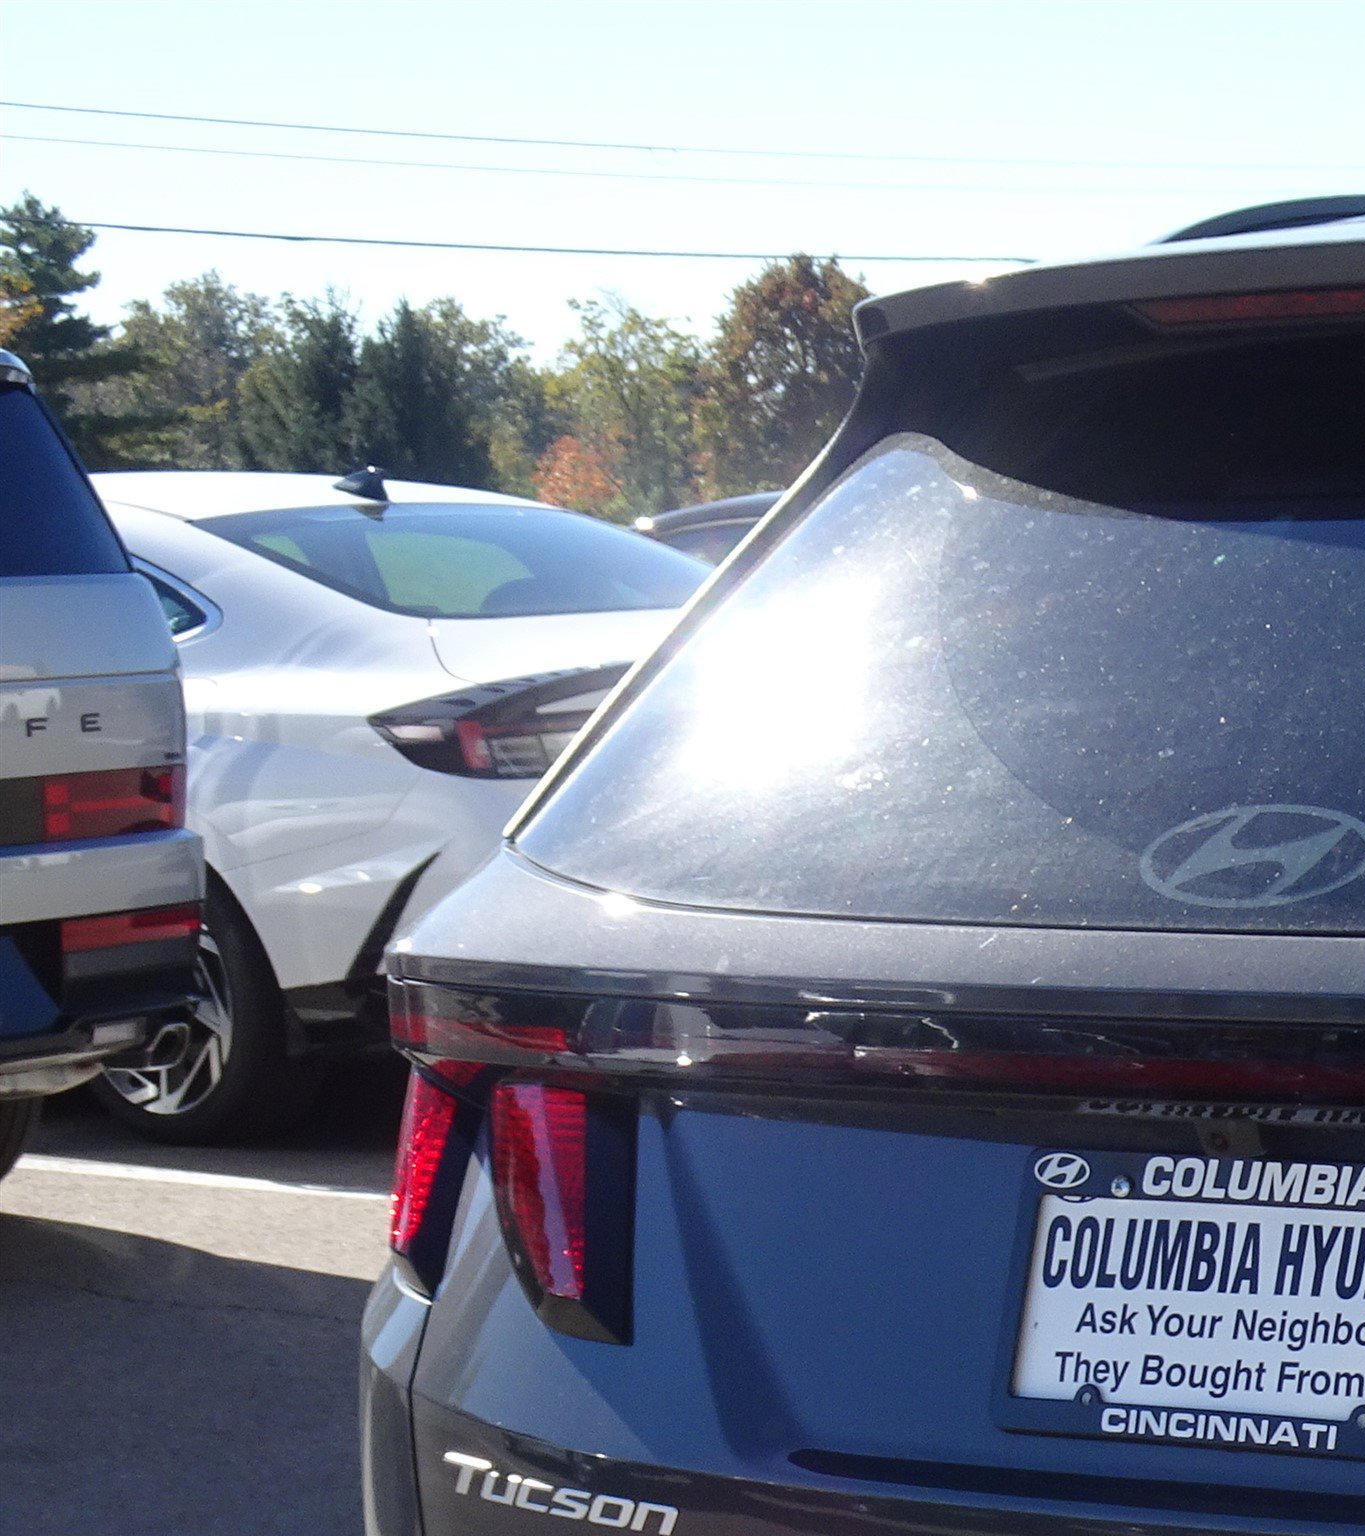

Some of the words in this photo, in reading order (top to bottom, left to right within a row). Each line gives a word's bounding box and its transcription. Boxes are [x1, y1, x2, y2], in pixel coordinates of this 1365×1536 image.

[1042, 1214, 1262, 1295] COLUMBIA
[1075, 1302, 1139, 1335] Ask
[1146, 1304, 1224, 1339] Your
[1055, 1350, 1130, 1393] They
[1140, 1353, 1266, 1399] Bought
[1276, 1360, 1365, 1398] From
[1101, 1407, 1339, 1451] CINCINNATI
[443, 1450, 680, 1536] Tucson
